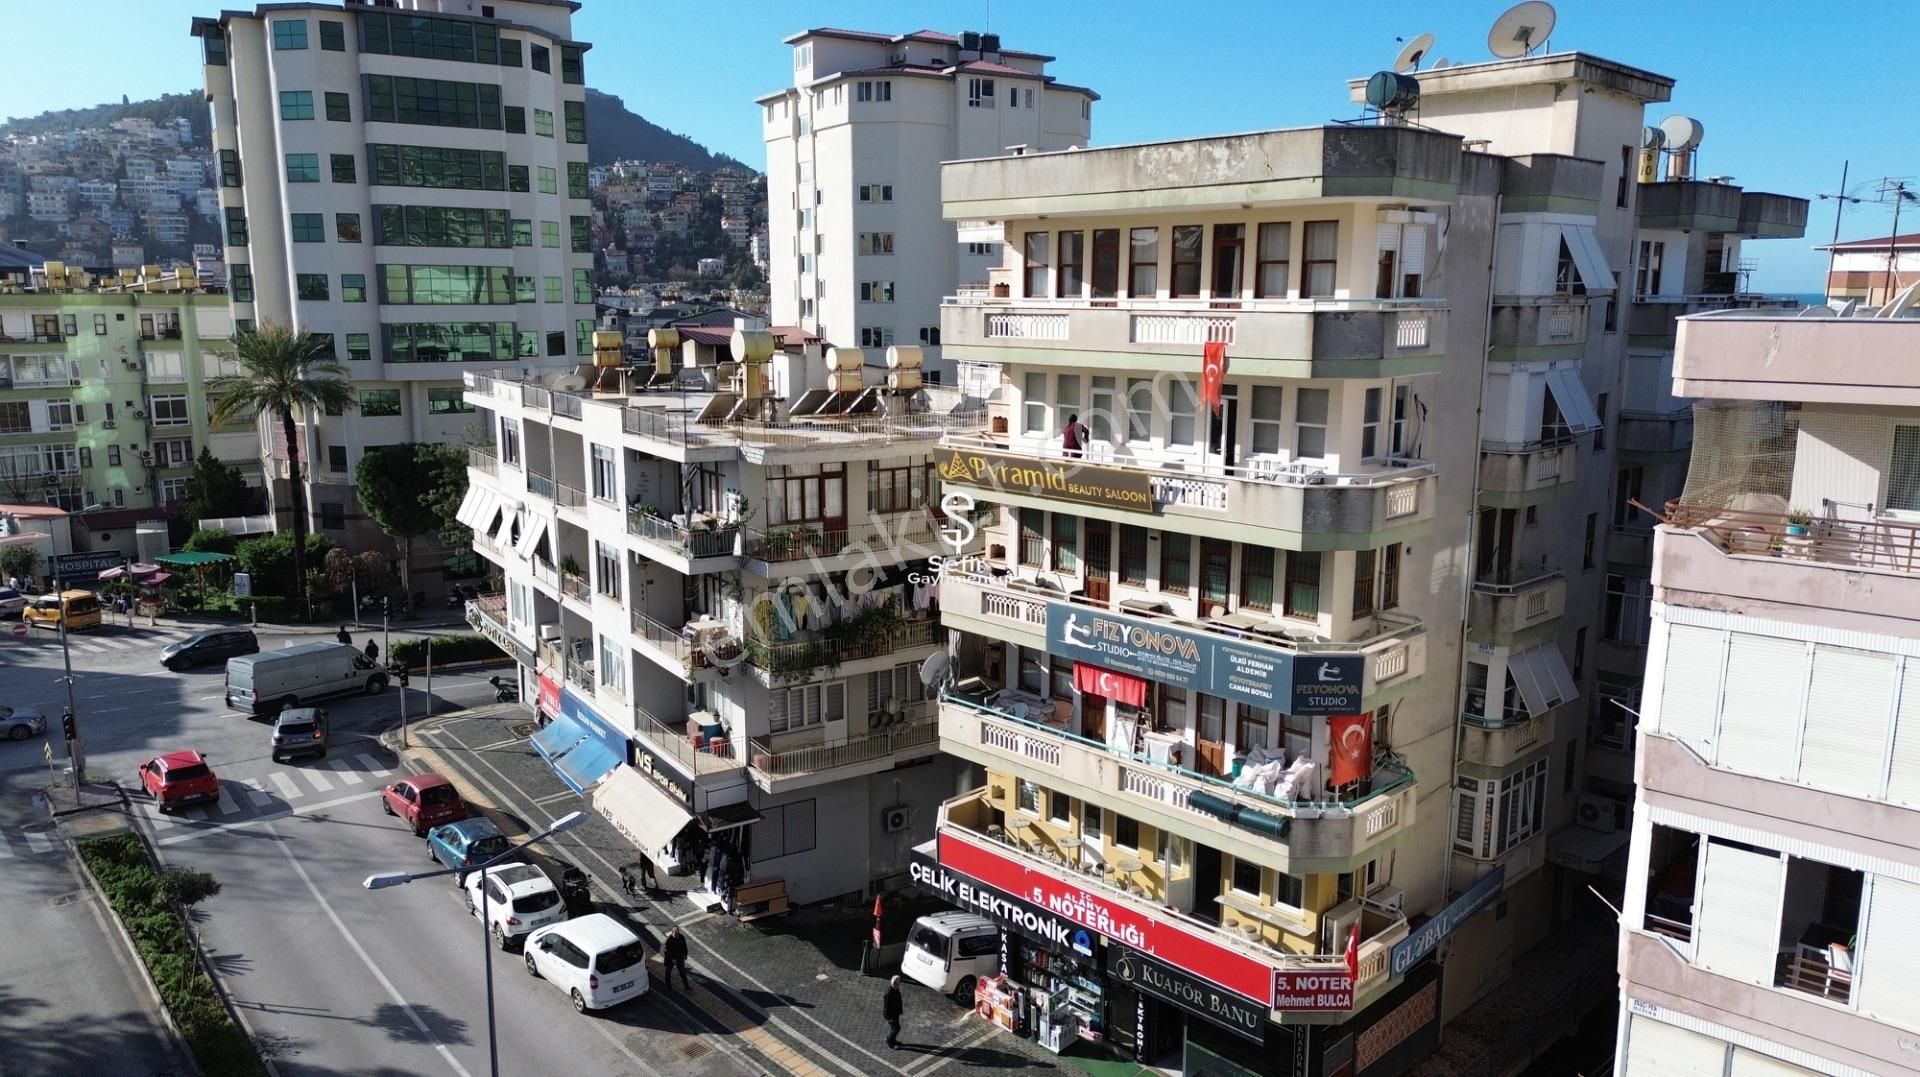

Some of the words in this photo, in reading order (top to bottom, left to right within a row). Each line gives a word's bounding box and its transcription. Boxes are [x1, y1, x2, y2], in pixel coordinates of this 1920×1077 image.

[969, 456, 1066, 491] Pyramid
[1068, 484, 1103, 497] BEAUTY
[1105, 488, 1147, 503] SALOON
[56, 559, 115, 571] HOSPITAL
[1097, 642, 1131, 658] STUDIO
[1230, 654, 1247, 665] ÜLKÜ
[1247, 659, 1274, 671] FERHAN
[1229, 683, 1250, 694] CANAN
[1250, 688, 1273, 699] BOYALI
[1308, 697, 1347, 706] STUDIO
[635, 747, 653, 774] NS
[652, 769, 669, 788] SPOR
[602, 806, 614, 821] NS
[910, 861, 956, 897] ÇELİK
[959, 882, 1071, 948] ELEKTRONİK
[1033, 887, 1046, 906] 5.
[1064, 892, 1110, 918] ALANYA
[1277, 977, 1292, 991] 5.
[1295, 976, 1351, 991] NOTER
[1142, 964, 1205, 1007] KUAFÖR
[1209, 993, 1258, 1029] BANU
[1276, 994, 1316, 1007] Mehmet
[1317, 993, 1351, 1007] BULCA
